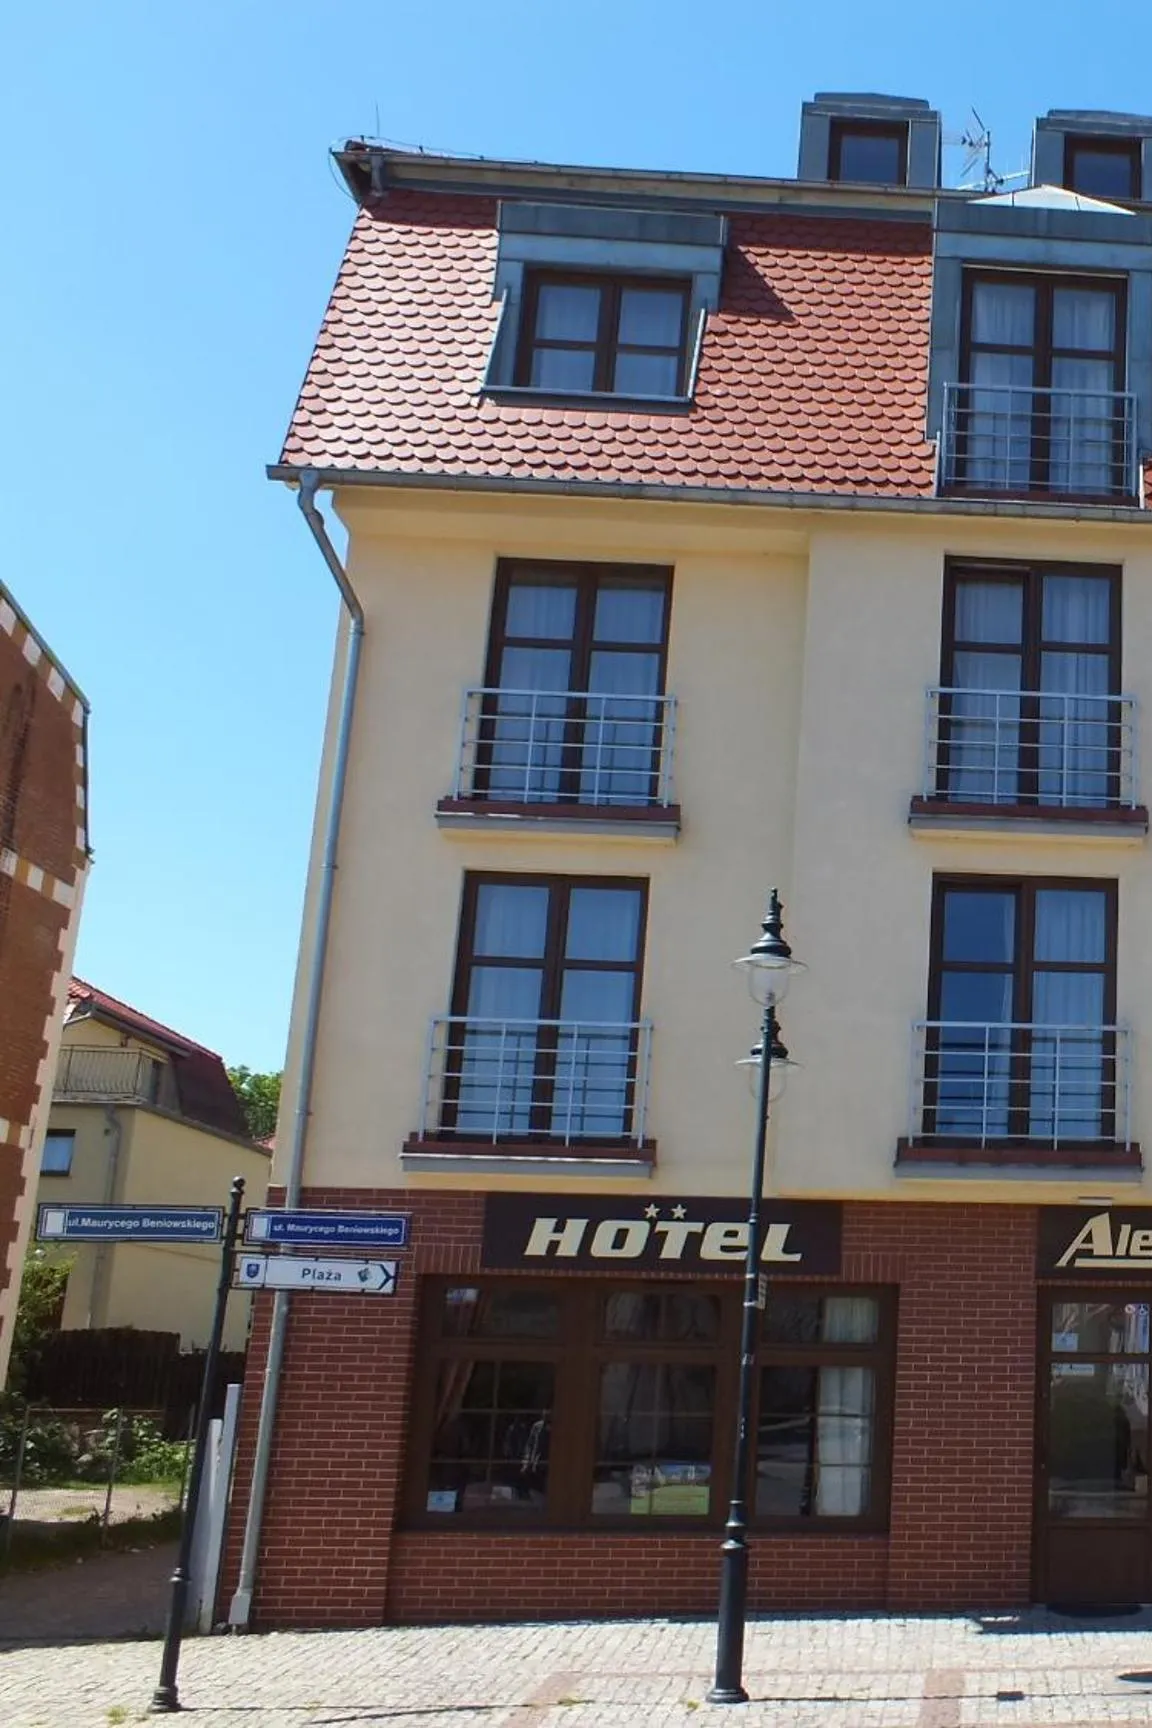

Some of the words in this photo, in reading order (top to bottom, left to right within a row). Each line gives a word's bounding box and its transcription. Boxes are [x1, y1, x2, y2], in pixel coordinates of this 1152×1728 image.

[81, 1217, 140, 1230] Maurycego
[141, 1217, 215, 1231] Beniowskiego
[301, 1267, 342, 1281] Plaża
